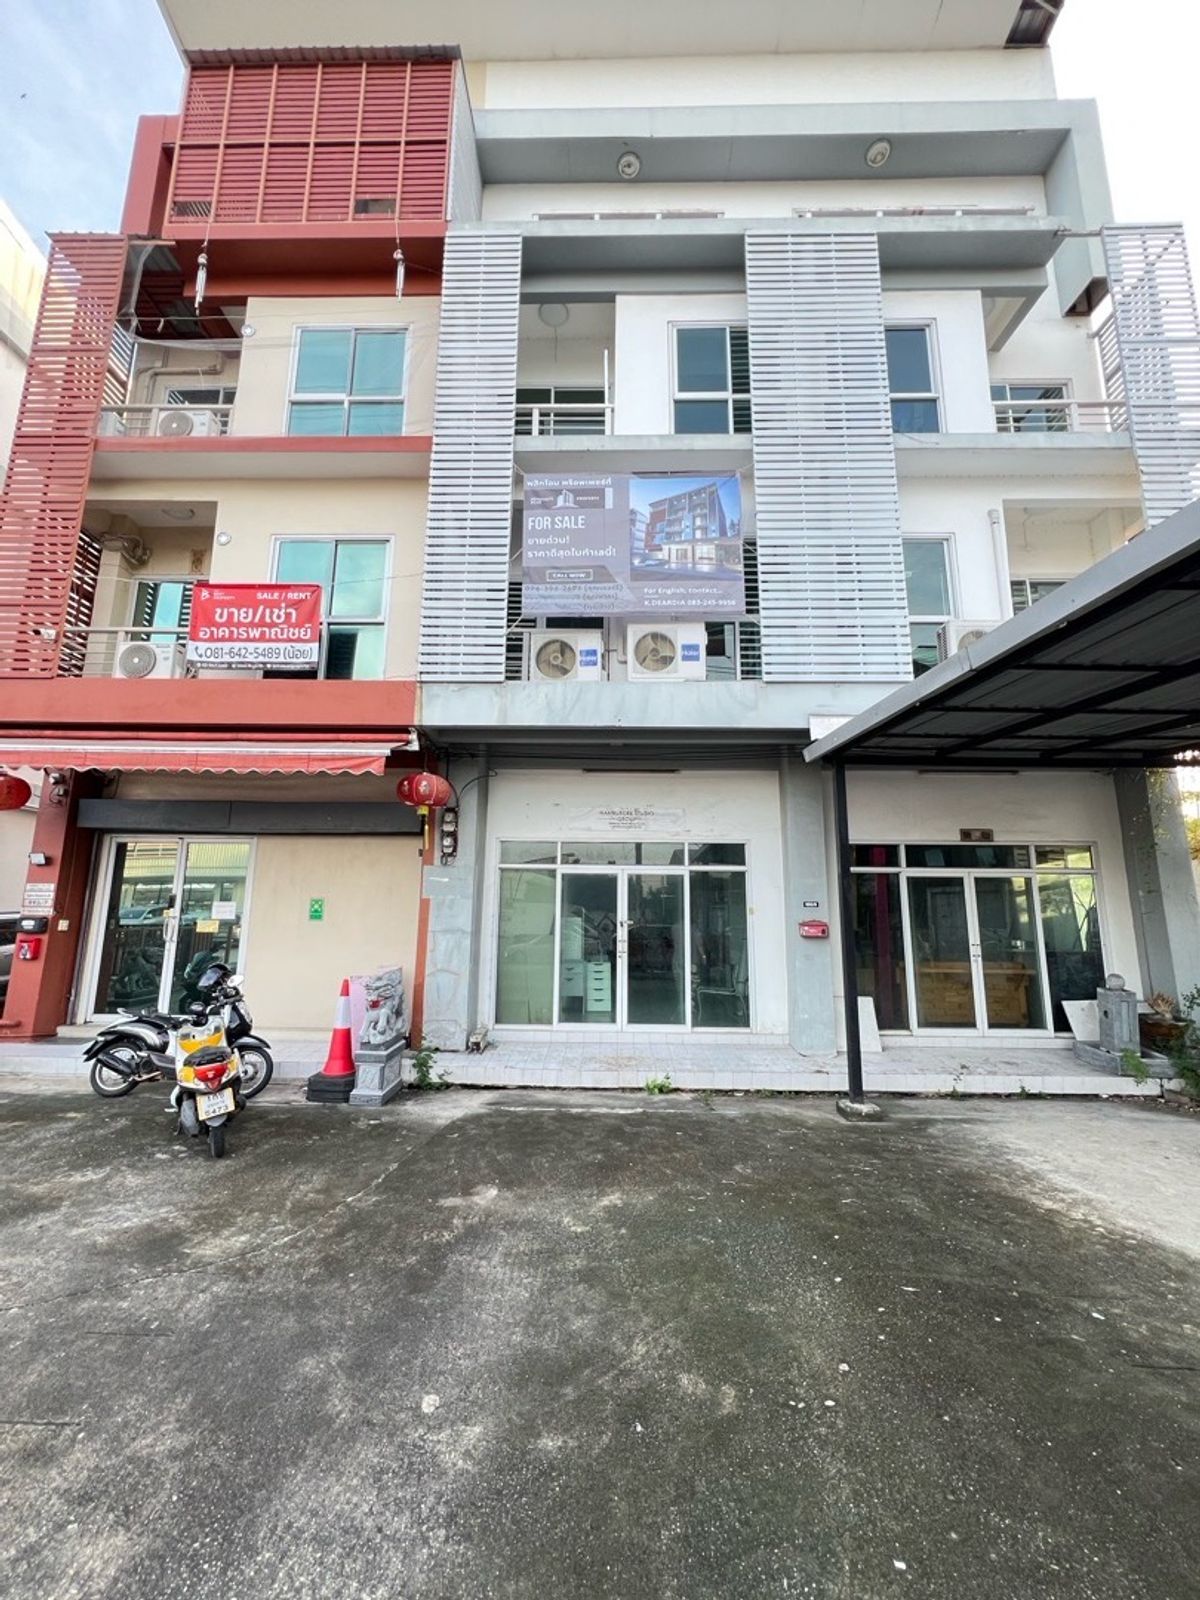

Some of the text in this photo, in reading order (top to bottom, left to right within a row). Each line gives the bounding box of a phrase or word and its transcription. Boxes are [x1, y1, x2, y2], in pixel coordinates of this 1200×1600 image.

[528, 515, 586, 530] FOR SALE
[256, 592, 279, 600] SALE
[287, 592, 312, 600] RENT
[214, 603, 297, 623] ขาย/เช่า
[199, 623, 312, 640] อาคารพาณิชย์
[204, 645, 313, 660] 081-642-5489 (น้อย)
